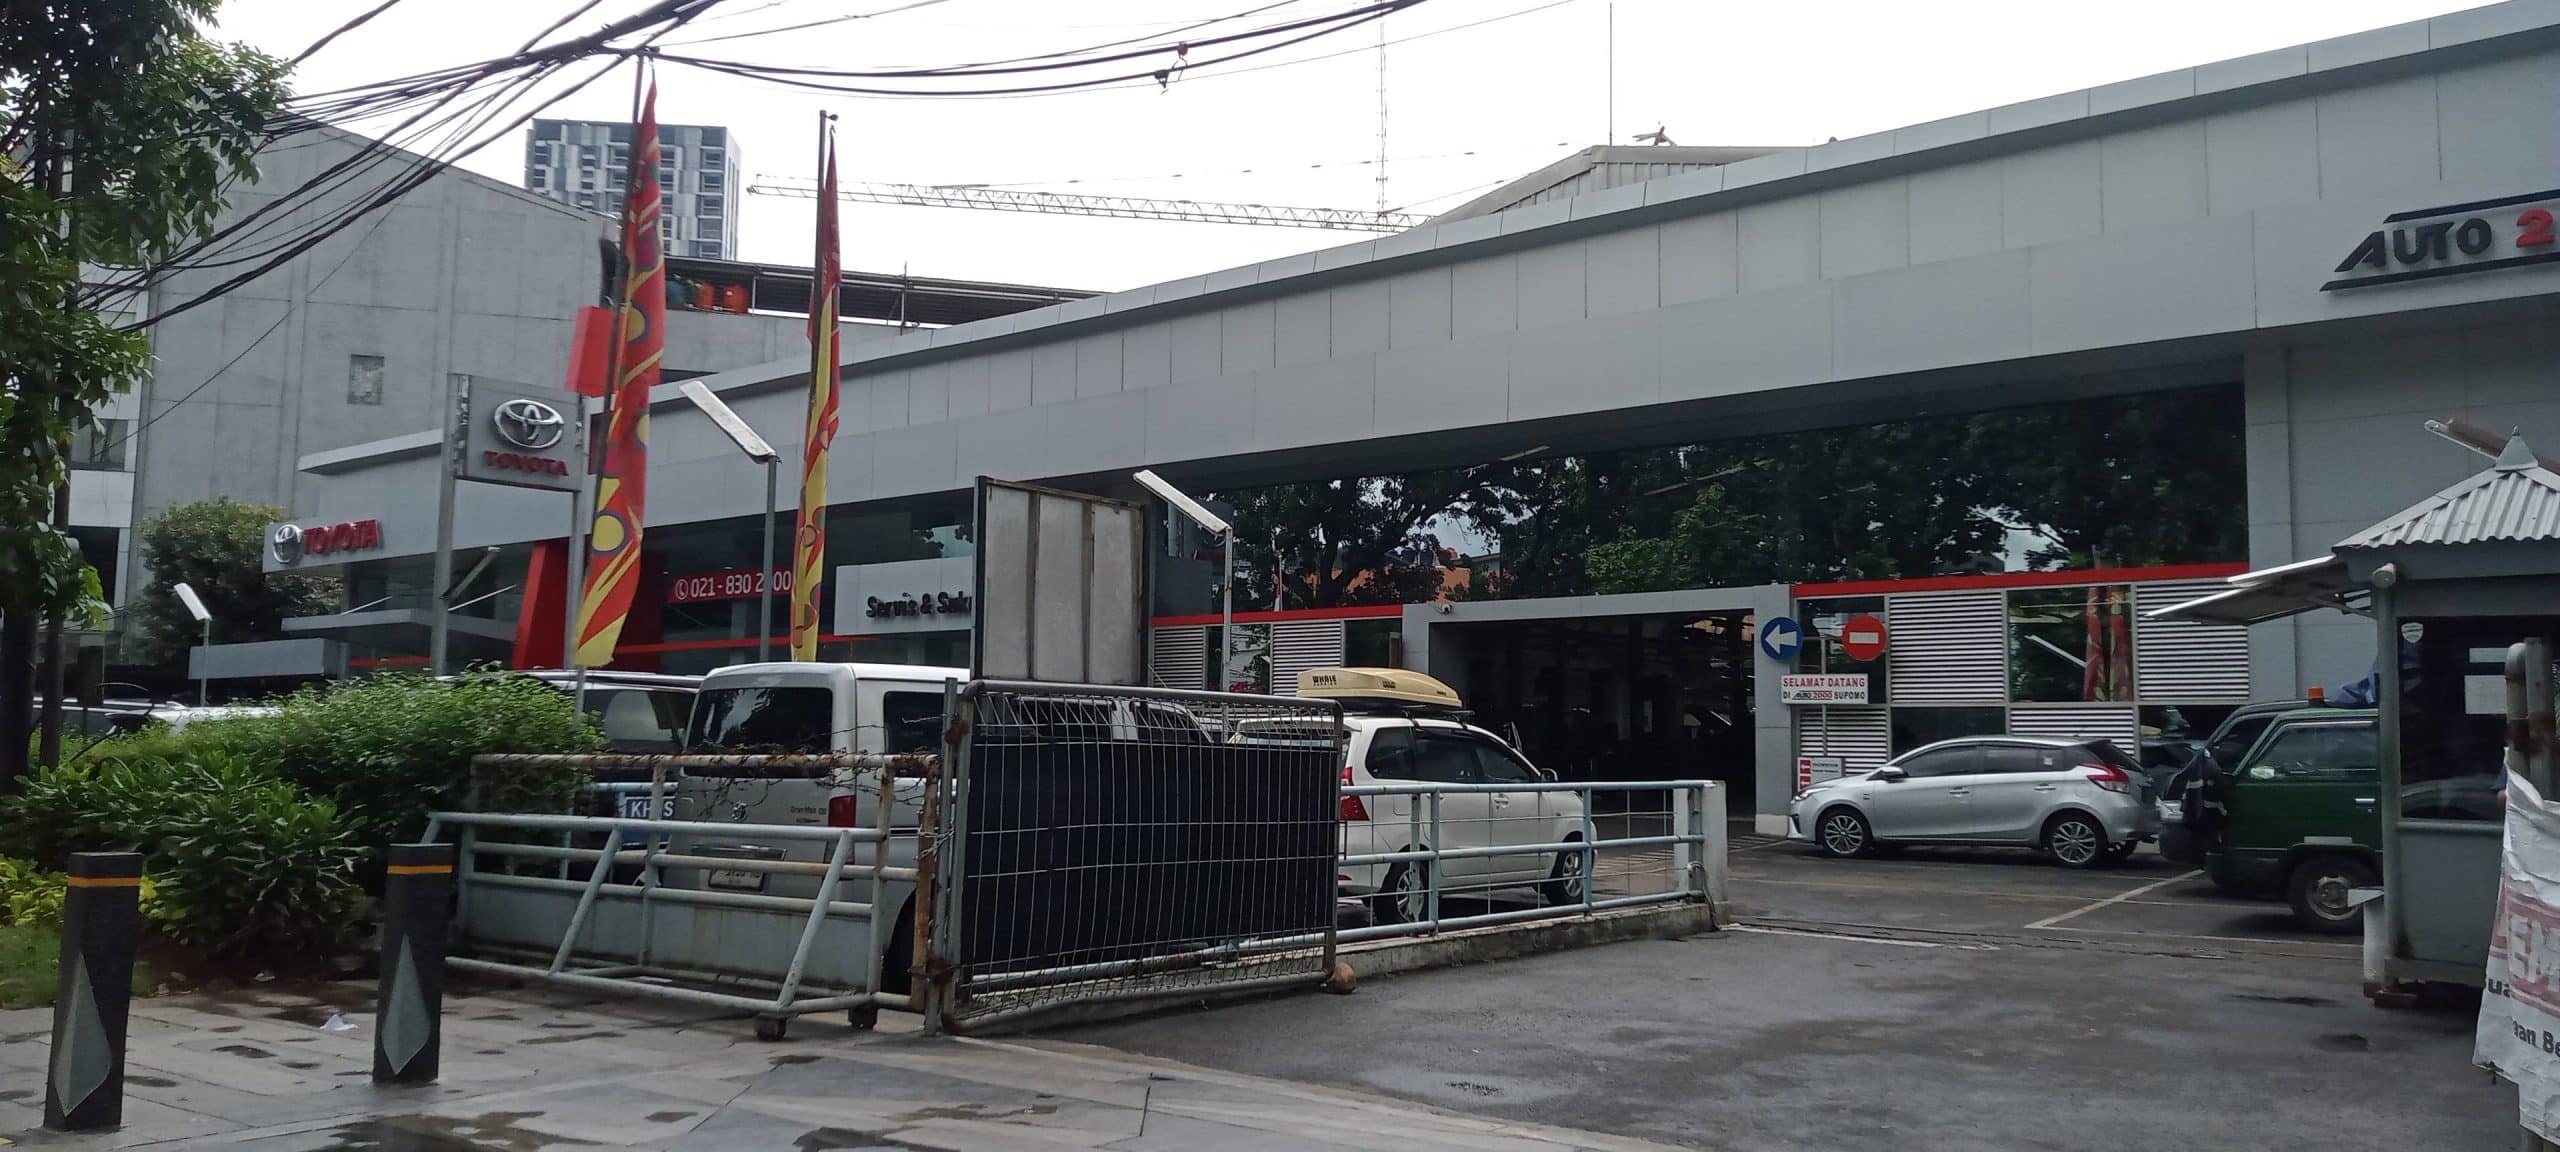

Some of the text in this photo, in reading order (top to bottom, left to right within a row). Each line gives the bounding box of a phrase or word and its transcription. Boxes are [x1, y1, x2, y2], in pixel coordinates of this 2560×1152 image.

[2333, 217, 2493, 273] AUTO
[484, 450, 568, 476] TOYOTA
[303, 519, 379, 555] TOYOTA
[755, 570, 792, 592] 200
[865, 592, 919, 618] Servis
[1783, 677, 1865, 688] SELAMAT DATANG
[1782, 691, 1791, 700] DI
[631, 800, 675, 817] KHS
